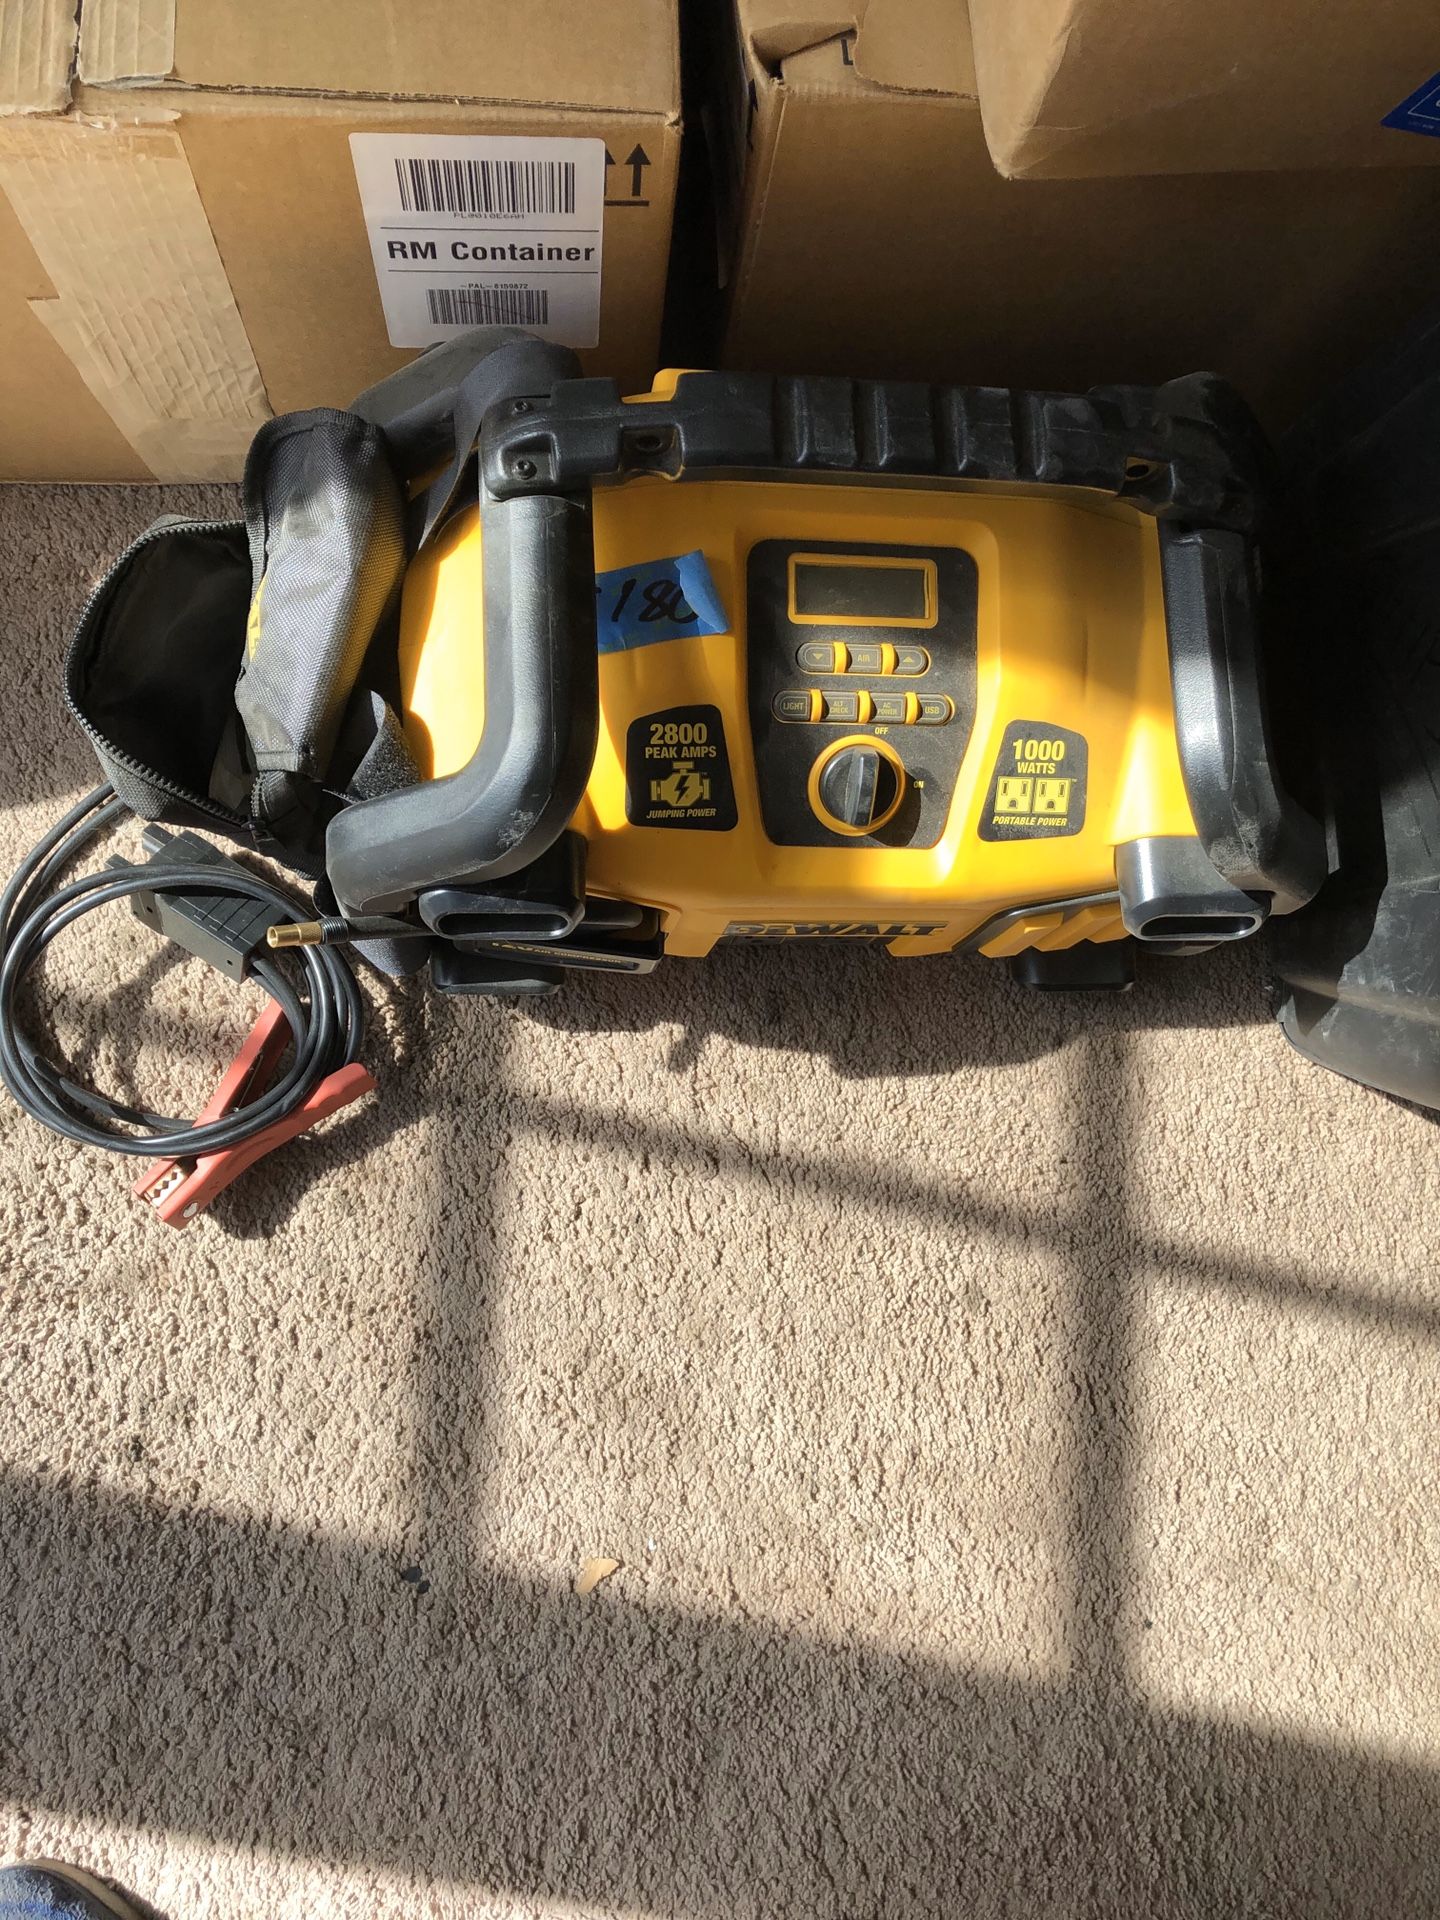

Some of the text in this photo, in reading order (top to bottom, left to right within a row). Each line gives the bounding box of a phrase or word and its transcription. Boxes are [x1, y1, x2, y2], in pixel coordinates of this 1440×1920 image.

[387, 240, 595, 261] RM Container
[857, 654, 870, 663] AIR
[783, 702, 804, 711] LIGHT
[924, 706, 940, 714] USB
[649, 722, 708, 745] 2800
[874, 726, 889, 735] OFF
[645, 745, 717, 759] PEAK AMPS
[1012, 739, 1066, 761] 1000
[1017, 762, 1057, 774] WATTS
[913, 781, 925, 789] ON
[646, 808, 717, 819] JUMPING POWER
[992, 816, 1068, 827] PORTABLE POWER
